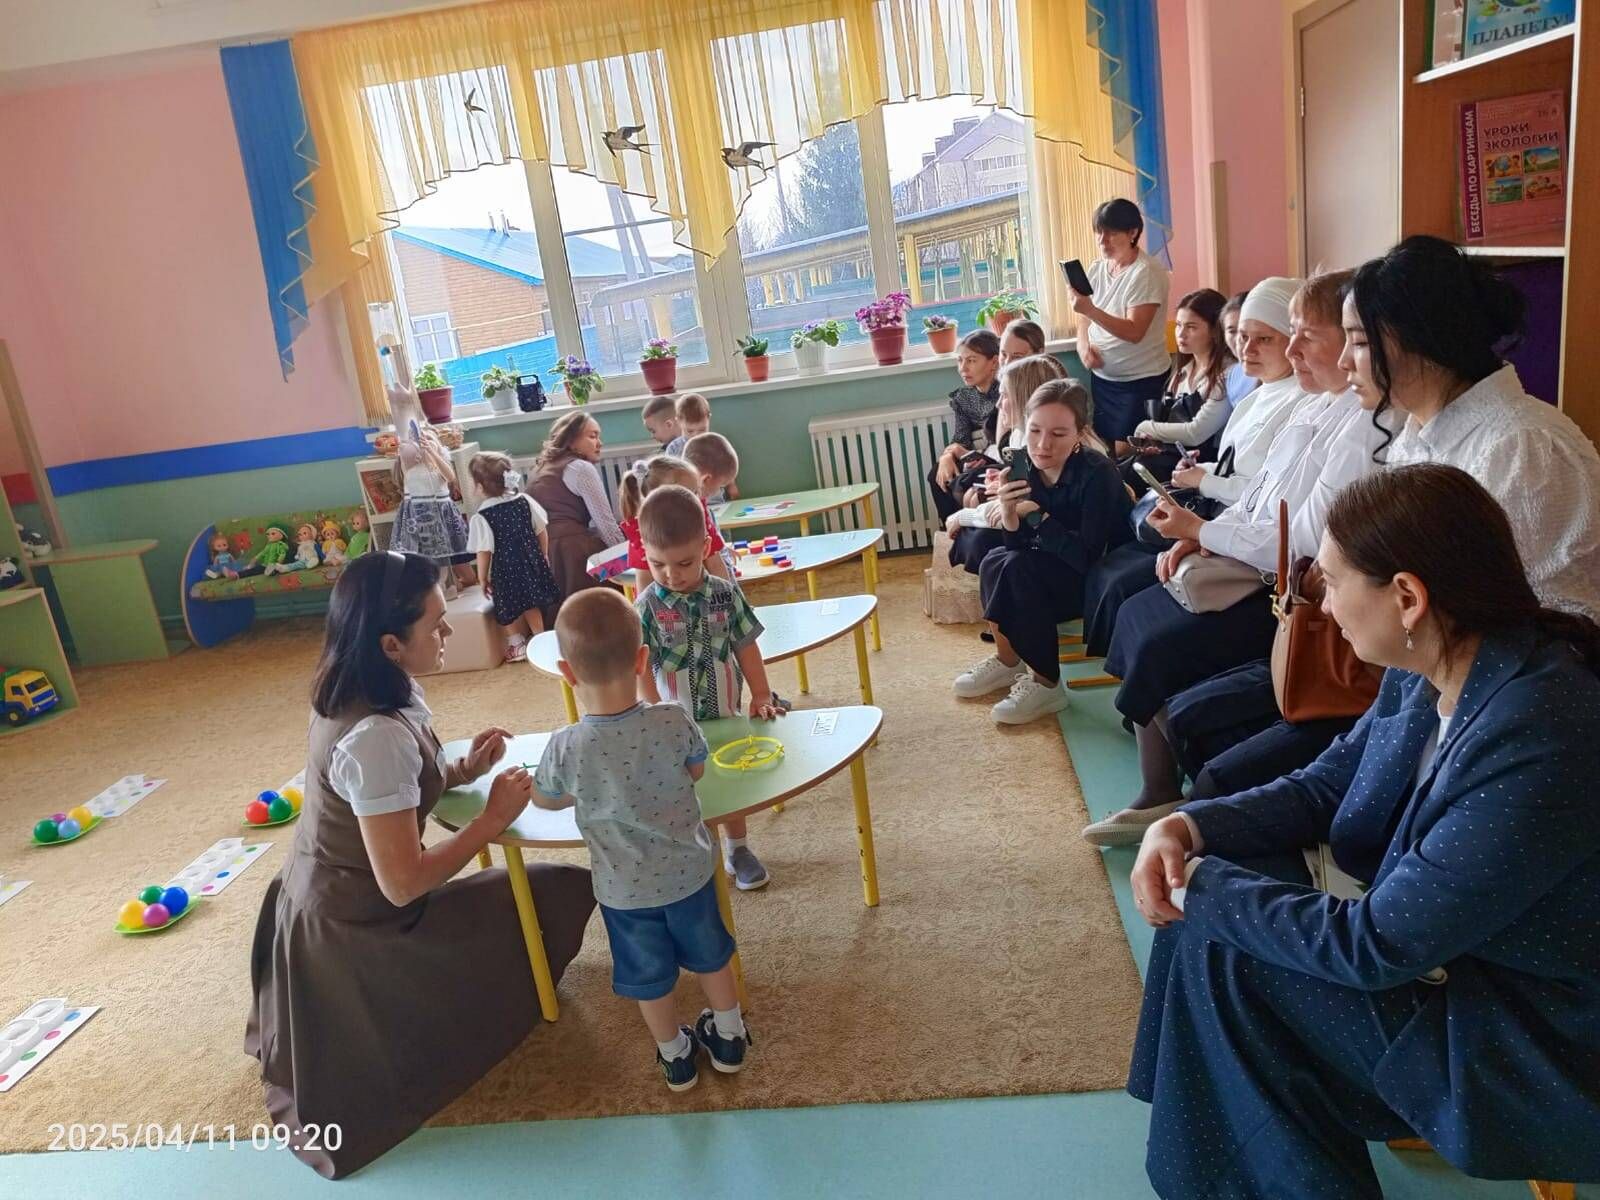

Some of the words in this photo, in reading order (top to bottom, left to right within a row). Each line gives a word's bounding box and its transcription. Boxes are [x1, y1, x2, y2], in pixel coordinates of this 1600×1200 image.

[1483, 122, 1529, 137] УРОКИ
[1465, 110, 1477, 174] КАРТИНКАМ
[1484, 131, 1559, 150] ЭКОЛОГИИ
[1468, 175, 1478, 192] ПО
[1470, 194, 1481, 233] БЕСЕДЫ
